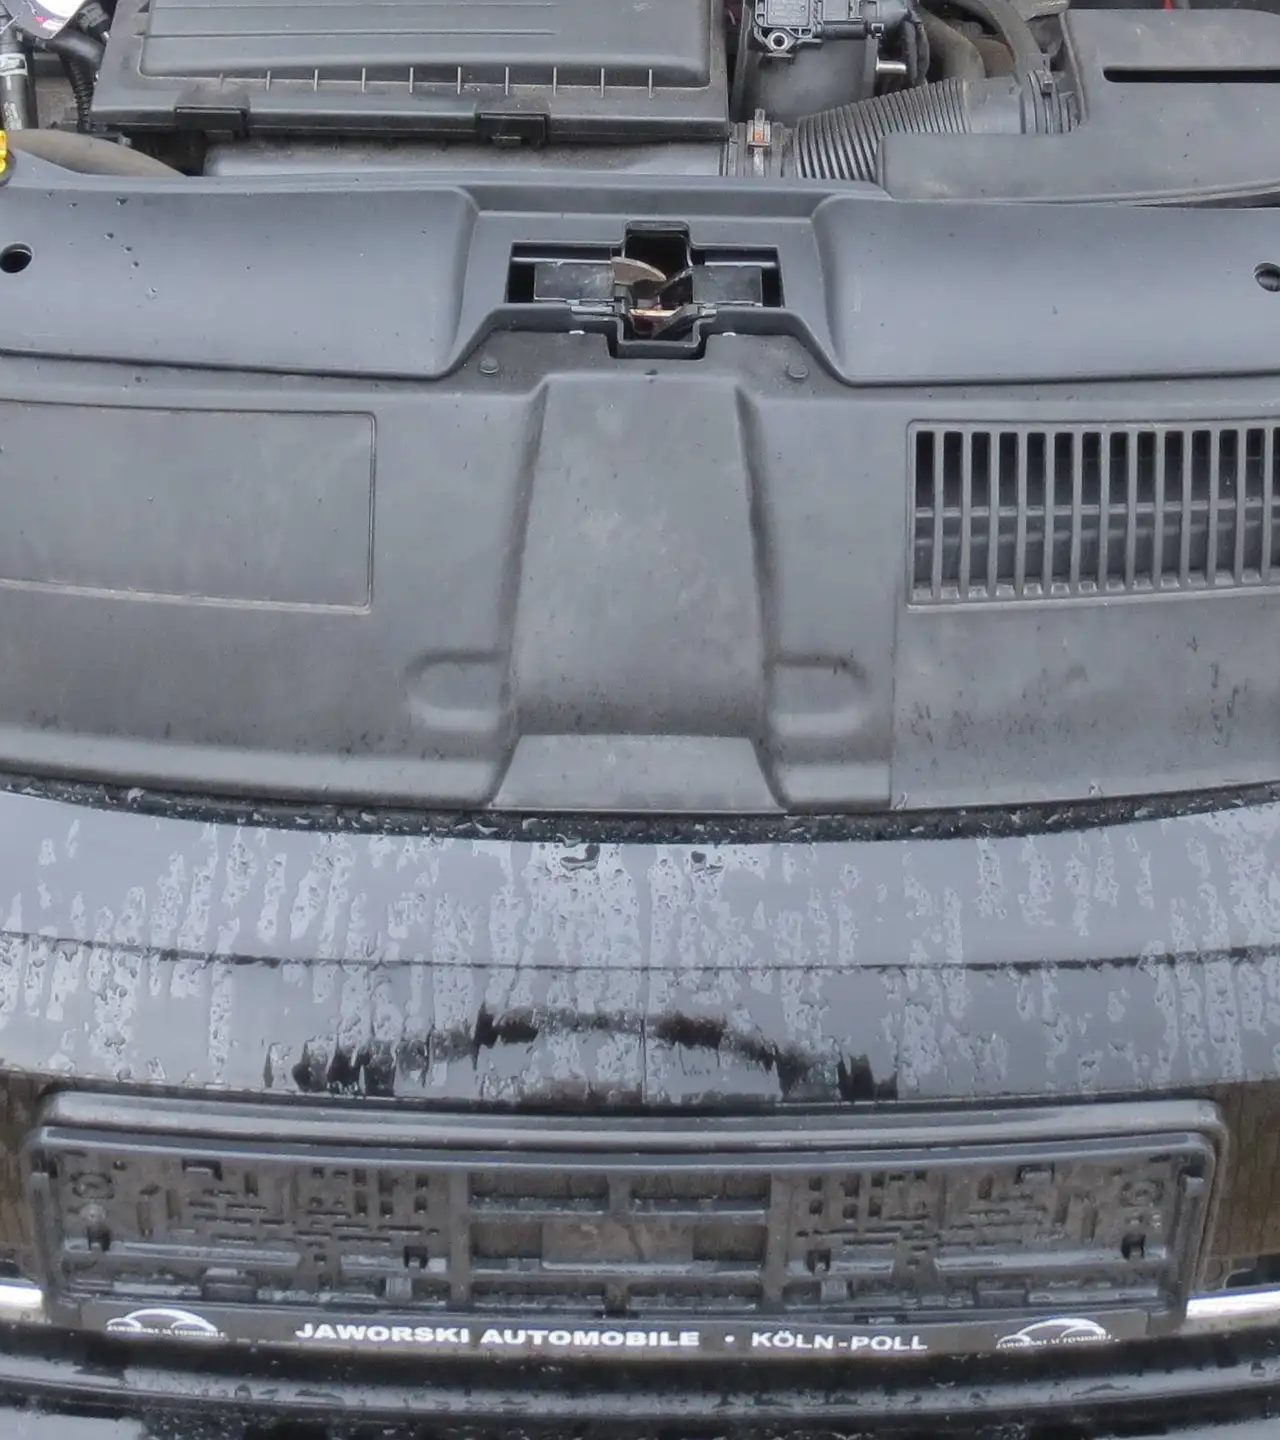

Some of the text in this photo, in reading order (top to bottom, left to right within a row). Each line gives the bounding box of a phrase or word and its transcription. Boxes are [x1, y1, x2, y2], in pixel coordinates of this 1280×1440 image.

[294, 1322, 928, 1350] JAWORSKI AUTOMOBILE KÖLN-POLL
